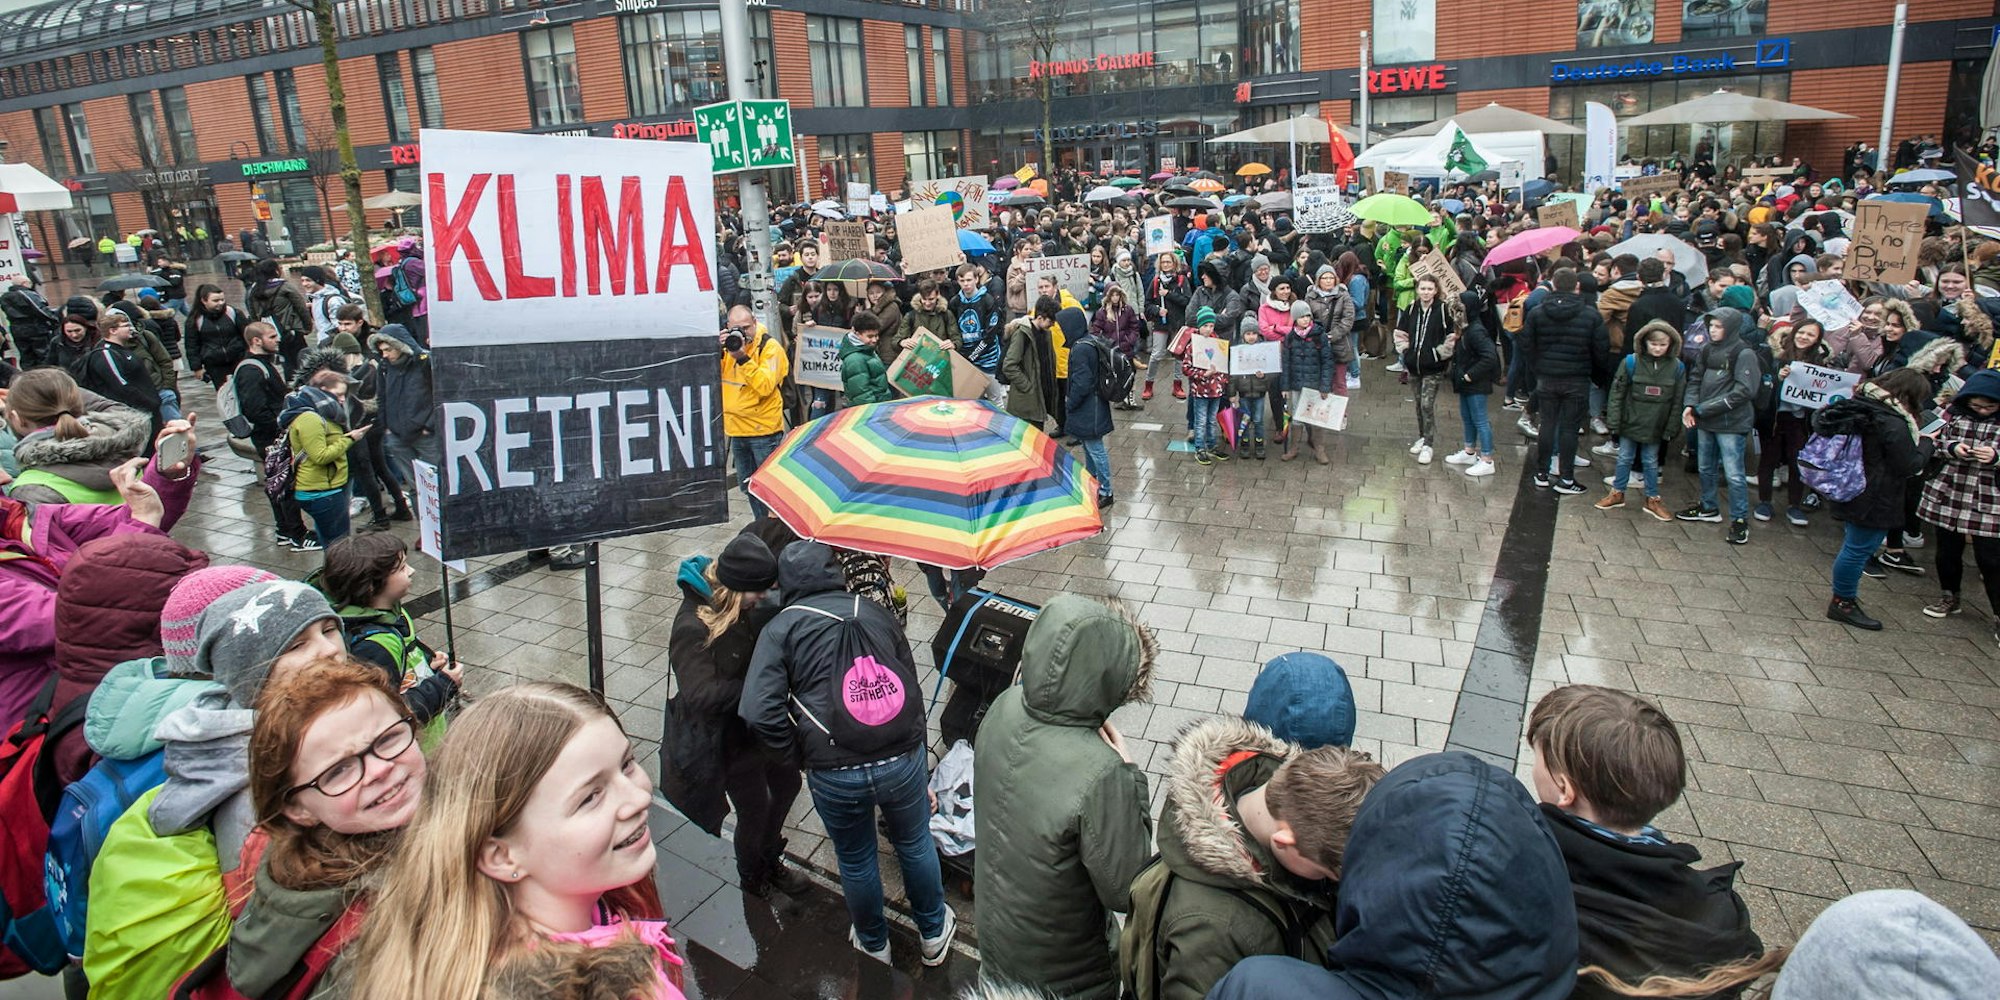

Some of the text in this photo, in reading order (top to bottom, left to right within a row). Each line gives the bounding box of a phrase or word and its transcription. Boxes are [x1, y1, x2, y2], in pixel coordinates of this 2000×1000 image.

[1552, 52, 1737, 82] Deutsche Bank
[1367, 64, 1446, 94] REWE
[1034, 120, 1158, 143] KNOPOLIS
[241, 157, 309, 176] DEICHMANN
[1858, 204, 1923, 233] There
[428, 172, 714, 301] KLIMA
[1856, 229, 1904, 248] is no
[1040, 258, 1079, 270] BELIEVE
[1853, 245, 1907, 271] Planet
[807, 338, 843, 349] KLIMAS
[823, 350, 841, 361] STA
[1803, 364, 1842, 381] There's
[1785, 385, 1827, 402] PLANET
[1812, 379, 1828, 388] NO
[442, 385, 713, 496] RETTEN!
[984, 598, 1038, 621] FAME
